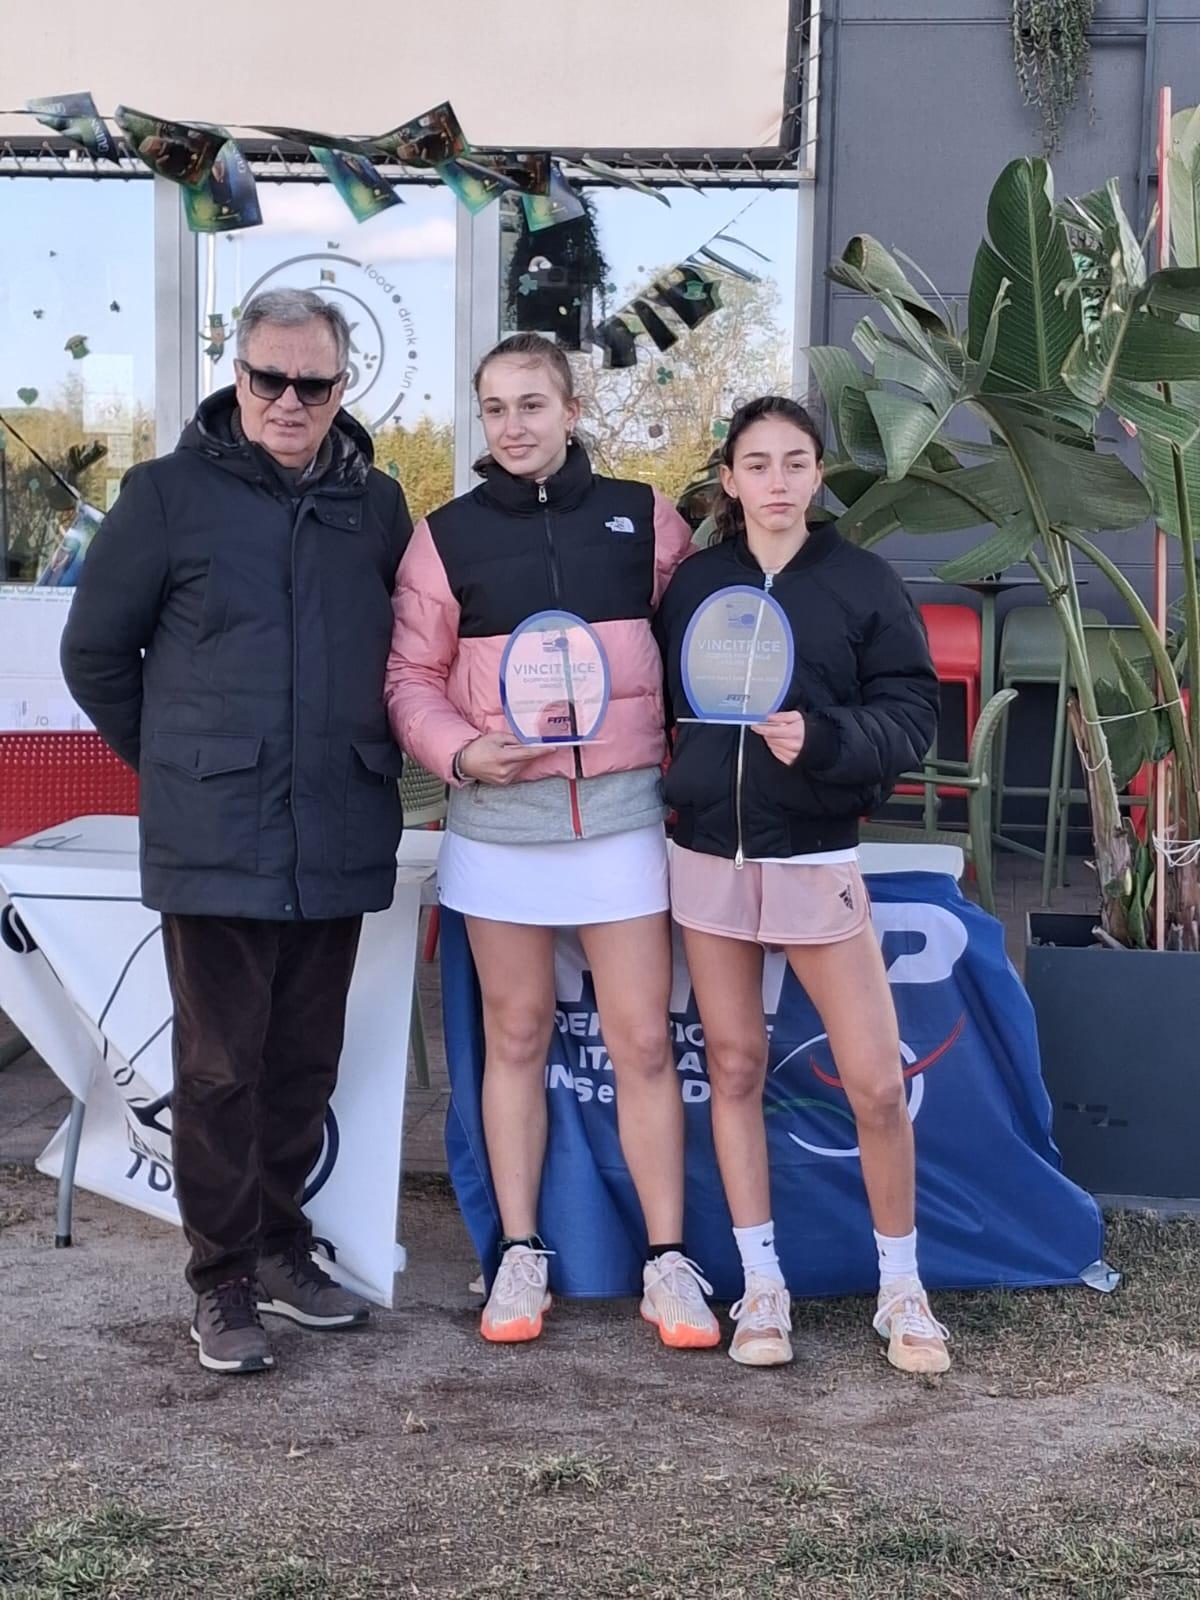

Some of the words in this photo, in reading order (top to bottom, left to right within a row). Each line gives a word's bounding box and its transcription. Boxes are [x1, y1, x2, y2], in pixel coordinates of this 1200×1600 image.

[364, 264, 396, 294] food
[398, 307, 418, 346] drink
[401, 365, 418, 389] fun
[513, 662, 597, 675] VINCITICE
